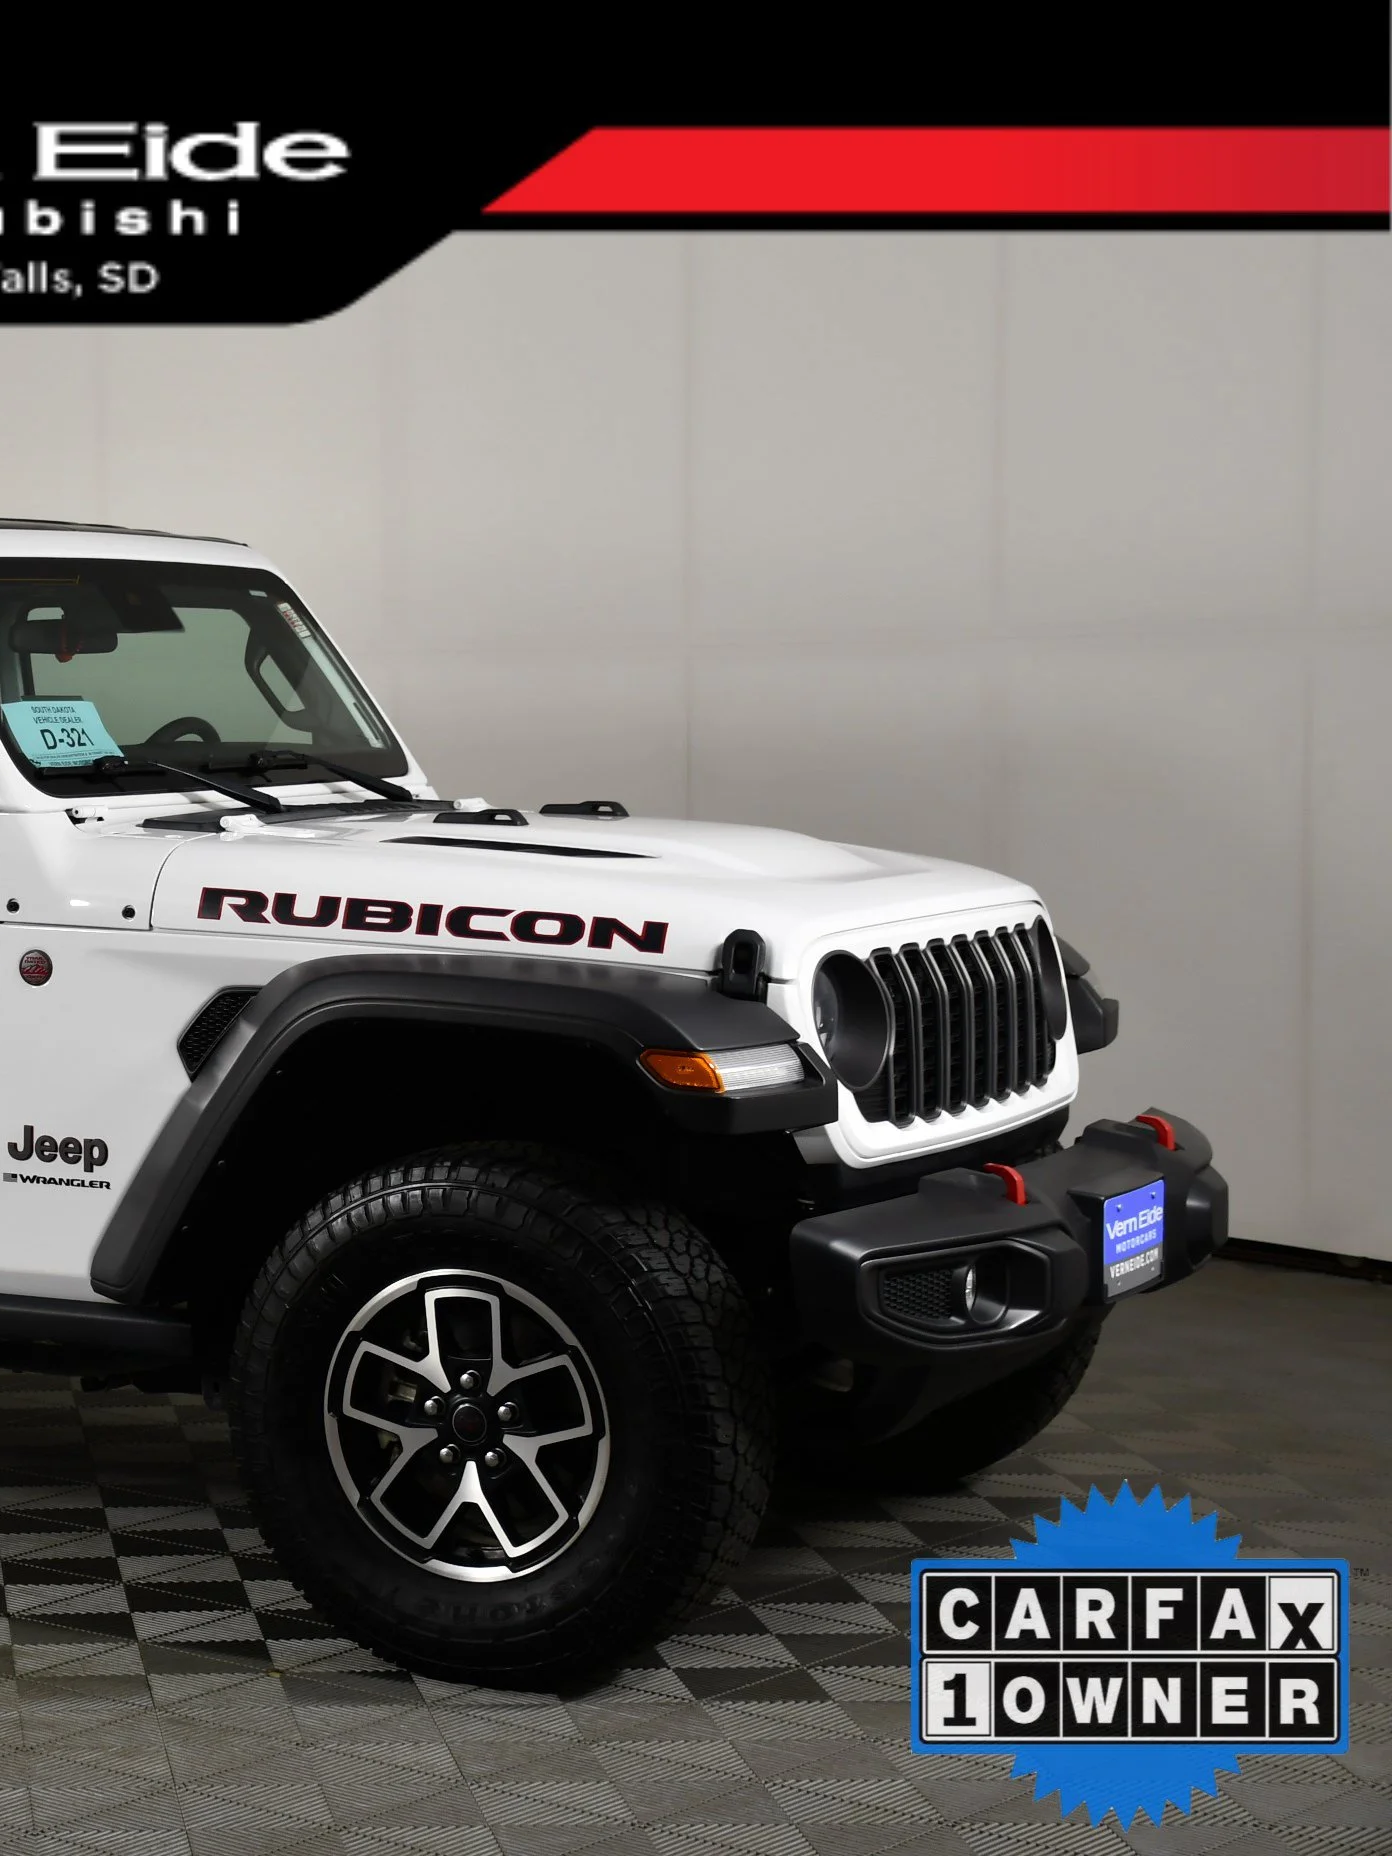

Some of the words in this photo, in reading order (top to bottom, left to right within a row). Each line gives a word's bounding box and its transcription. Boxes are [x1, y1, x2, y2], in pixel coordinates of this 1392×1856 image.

[52, 706, 76, 714] DAKOTA
[40, 728, 94, 750] D-321
[196, 886, 670, 954] RUBICON
[7, 1124, 109, 1173] Jeep
[19, 1173, 111, 1190] WRANGLER
[1106, 1216, 1138, 1240] Vern
[1138, 1205, 1164, 1229] Eide
[1115, 1229, 1157, 1254] MOTORCARS
[1110, 1247, 1159, 1279] VERNEIDE.COM
